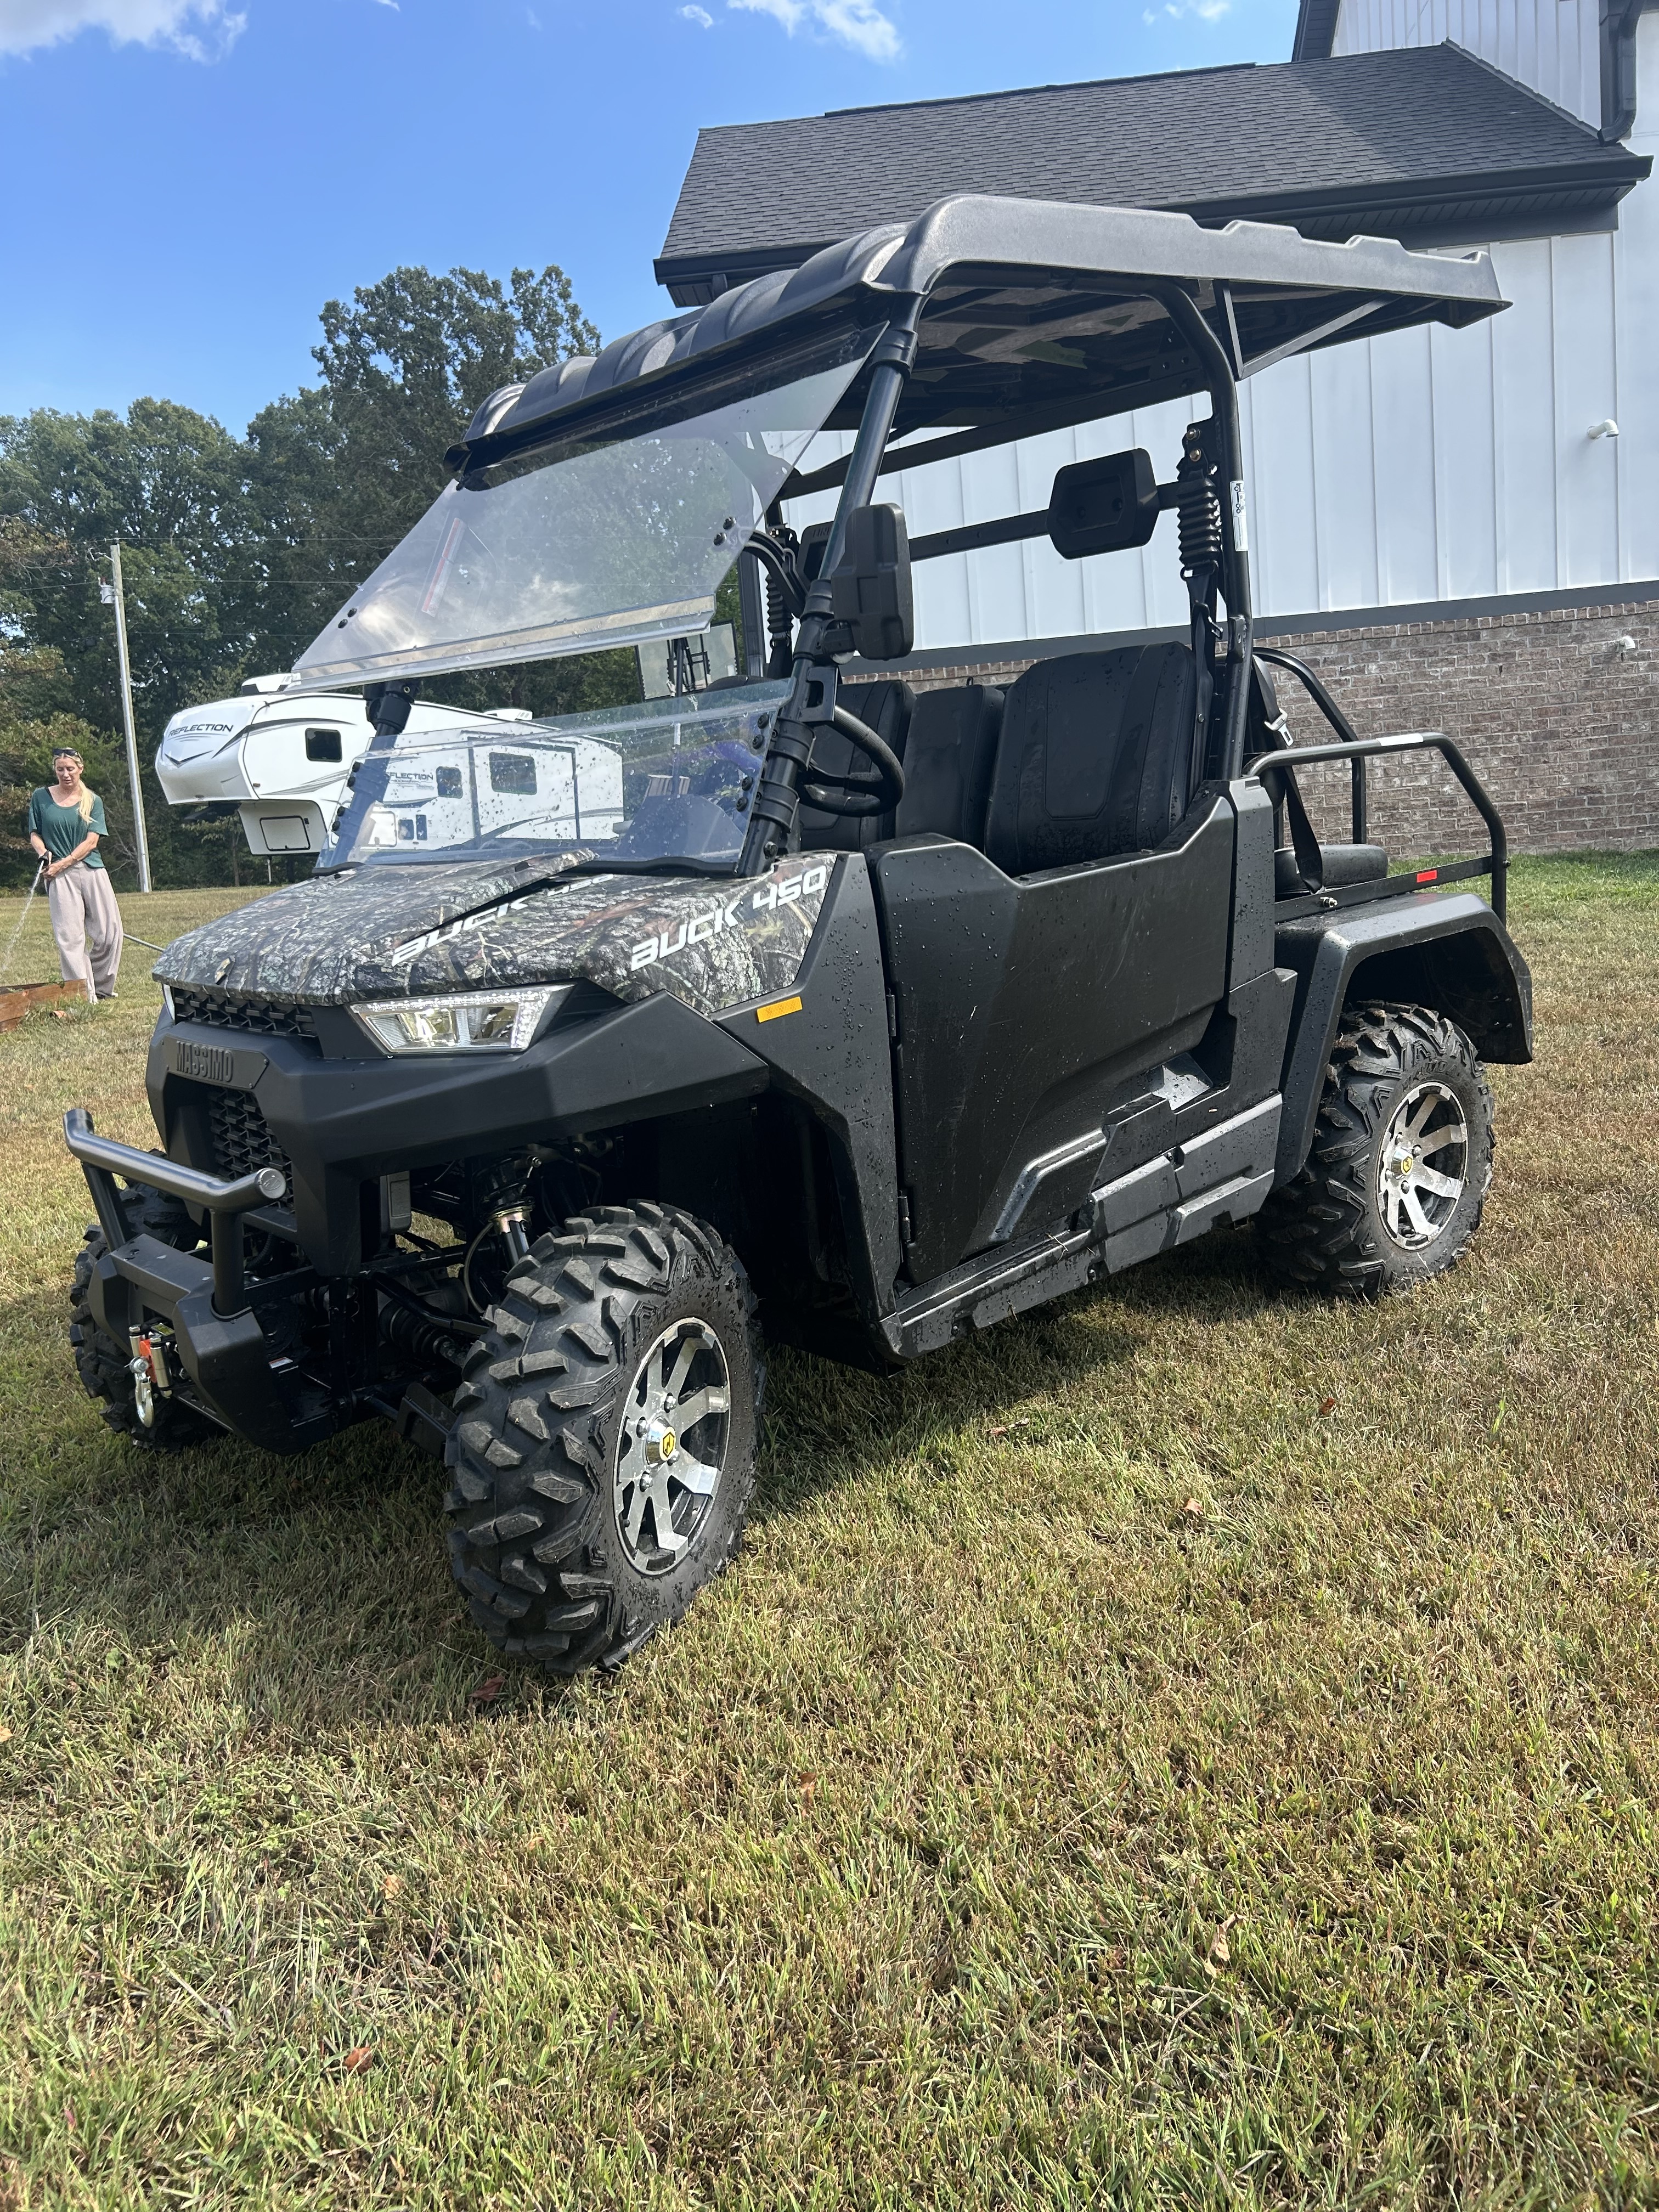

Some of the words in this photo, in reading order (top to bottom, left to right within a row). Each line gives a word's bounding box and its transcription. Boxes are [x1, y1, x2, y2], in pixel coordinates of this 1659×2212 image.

[168, 724, 234, 738] REFLECTION
[391, 896, 531, 967] BUCK
[547, 873, 614, 898] 450
[630, 900, 743, 972] BUCK
[752, 865, 827, 910] 450
[176, 1040, 234, 1082] MASSIMO
